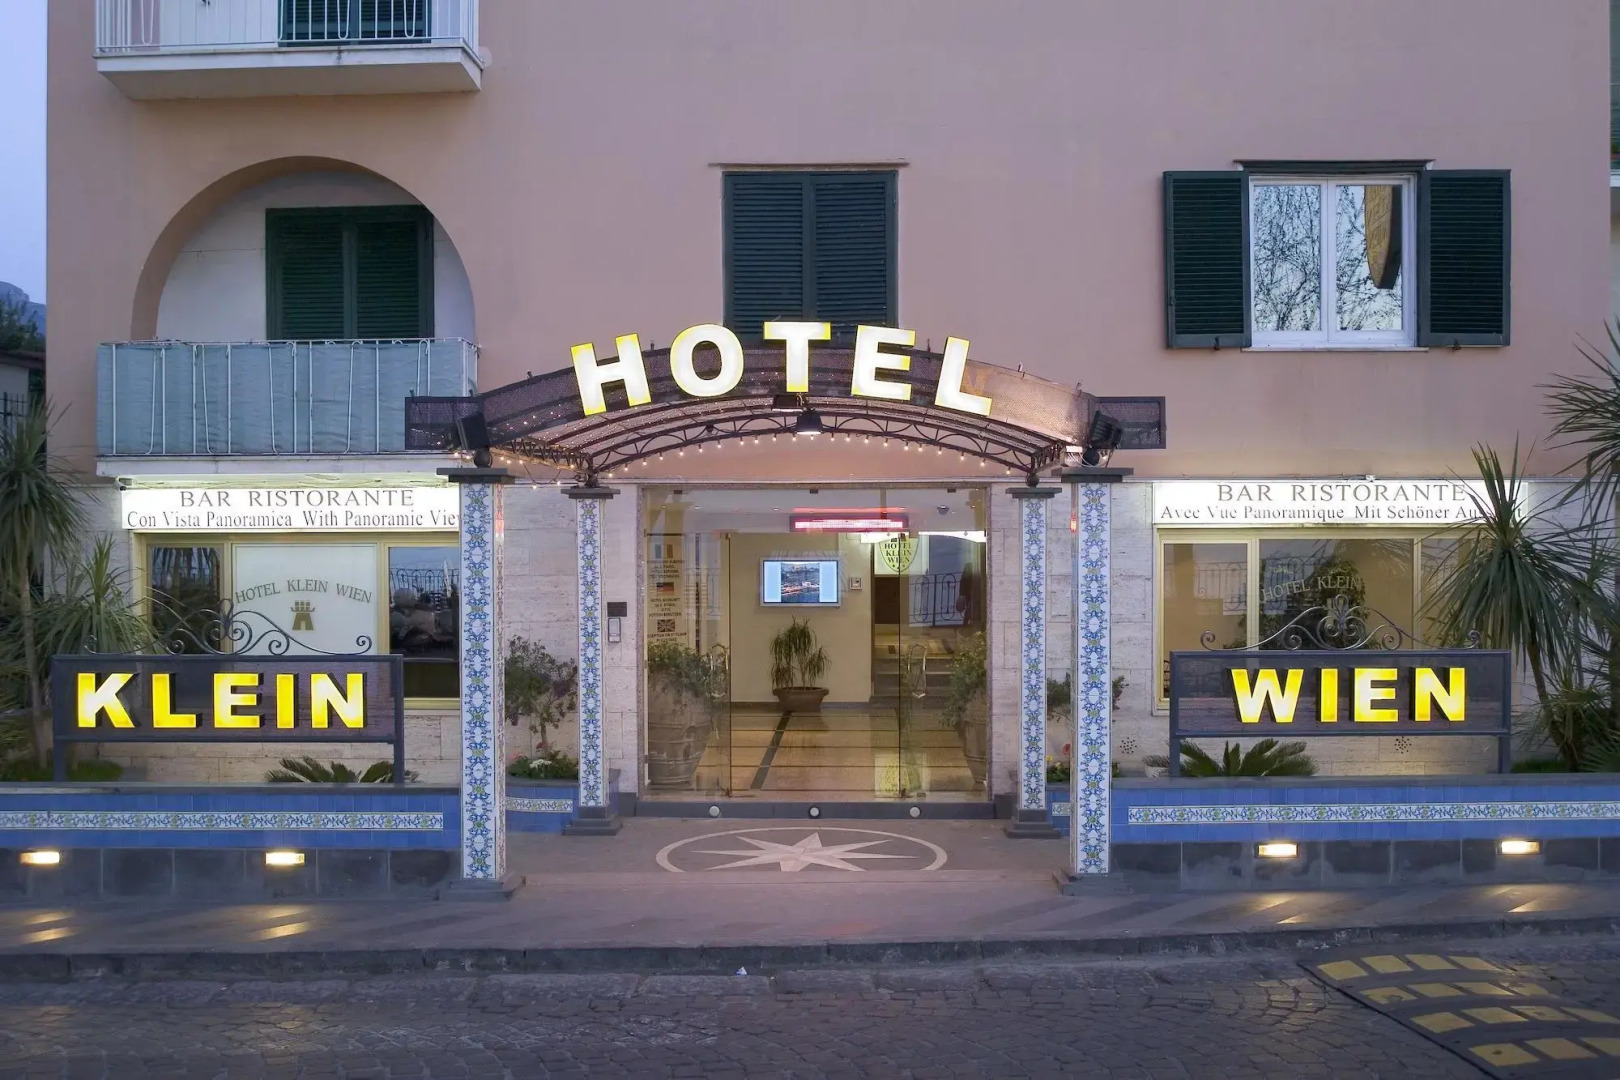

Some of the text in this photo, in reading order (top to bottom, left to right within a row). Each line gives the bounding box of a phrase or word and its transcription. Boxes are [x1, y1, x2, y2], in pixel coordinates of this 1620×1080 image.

[570, 321, 992, 416] HOTEL
[180, 490, 414, 507] BAR RISTORANTE
[1217, 484, 1466, 502] BAR RISTORANTE
[127, 509, 460, 527] Con Vista Panoramica With Panoramic Vie
[1160, 506, 1200, 519] Avec
[1207, 506, 1237, 519] Vue
[1244, 505, 1344, 522] Panoramique
[1355, 505, 1381, 519] Mit
[1387, 505, 1450, 519] Schöner
[235, 578, 373, 604] HOTEL KLEIN WIEN
[1261, 575, 1361, 604] HOTEL KLEIN
[77, 672, 364, 729] KLEIN
[1231, 667, 1466, 723] WIEN
